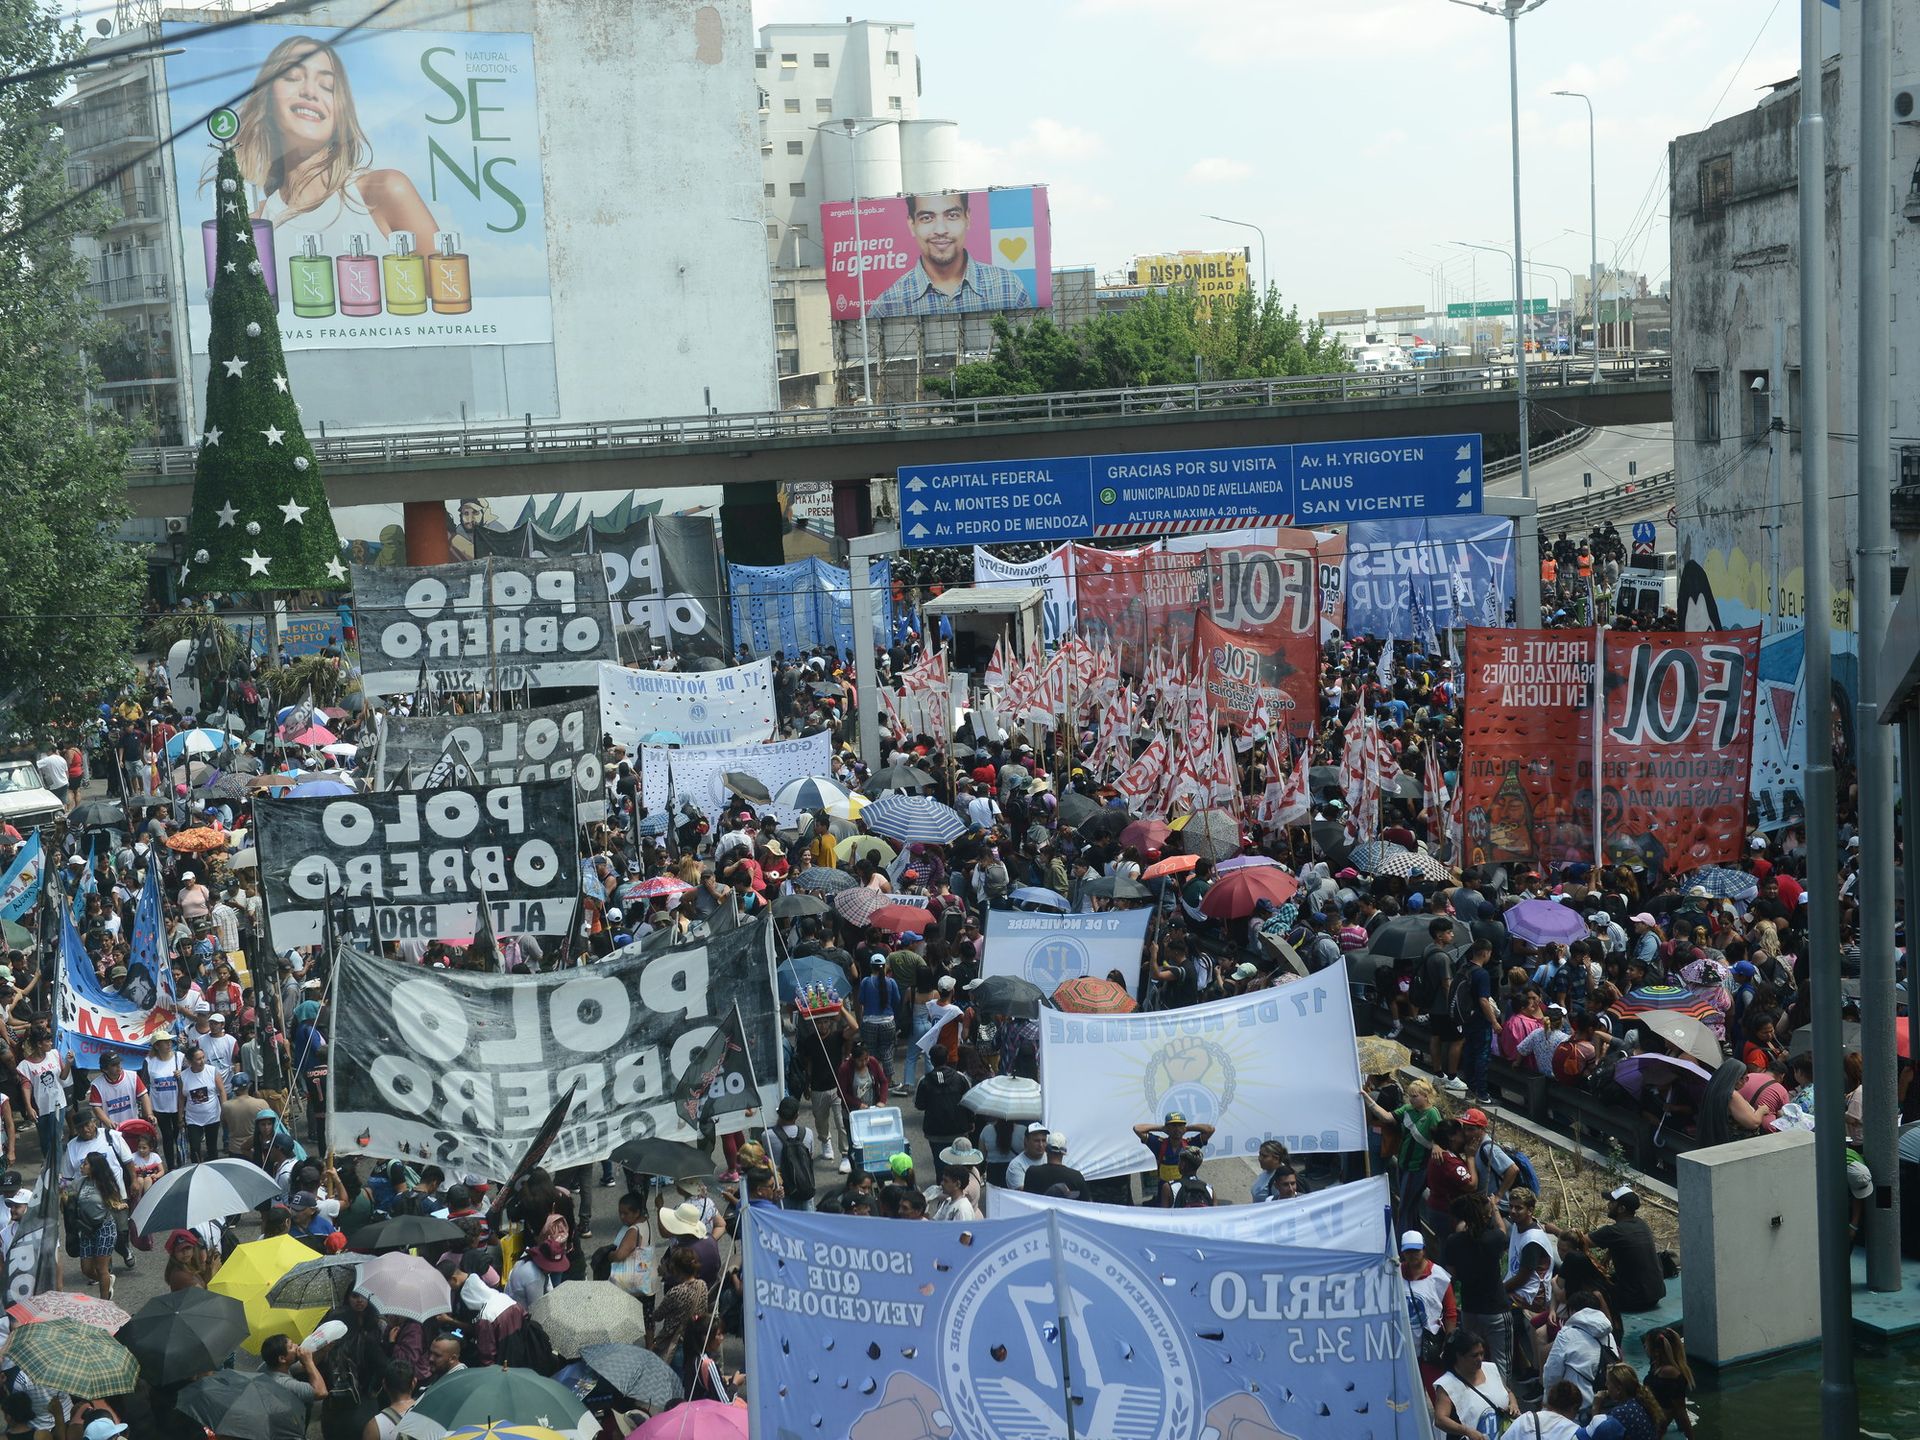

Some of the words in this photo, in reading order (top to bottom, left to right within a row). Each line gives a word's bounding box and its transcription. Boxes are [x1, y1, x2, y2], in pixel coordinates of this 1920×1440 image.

[465, 51, 511, 62] NATURAL
[466, 63, 519, 74] EMOTIONS
[830, 206, 886, 218] argentia.gob.ar
[833, 236, 895, 257] primero
[831, 256, 845, 273] la
[847, 250, 909, 278] gente
[1150, 261, 1235, 281] DISPONIBLE
[320, 326, 412, 340] FRAGANCIAS
[417, 324, 498, 335] NATURALES
[1107, 462, 1173, 479] GRACIAS
[1175, 460, 1207, 475] POR
[1209, 459, 1229, 474] SU
[1231, 456, 1277, 472] VISITA
[1300, 456, 1322, 469] Av.
[931, 471, 988, 490] CAPITAL
[992, 469, 1054, 486] FEDERAL
[1301, 476, 1354, 492] LANUS
[795, 493, 816, 505] MAXI
[1122, 484, 1200, 502] MUNICIPALIDAD
[1202, 482, 1217, 498] DE
[1218, 479, 1284, 497] AVELLANEDA
[933, 499, 951, 513] Av.
[955, 495, 1010, 511] MONTES
[1013, 494, 1031, 508] DE
[1032, 492, 1063, 507] OCA
[1302, 499, 1341, 515] SAN
[1345, 494, 1426, 512] VICENTE
[1128, 508, 1171, 522] ALTURA
[1173, 507, 1216, 519] MAXIMA
[1217, 506, 1238, 517] 4.20
[1239, 505, 1261, 517] mts.
[935, 523, 953, 536] Av.
[956, 519, 1001, 535] PEDRO
[1004, 518, 1023, 531] DE
[1025, 514, 1088, 531] MENDOZA
[278, 632, 325, 645] ESPETO
